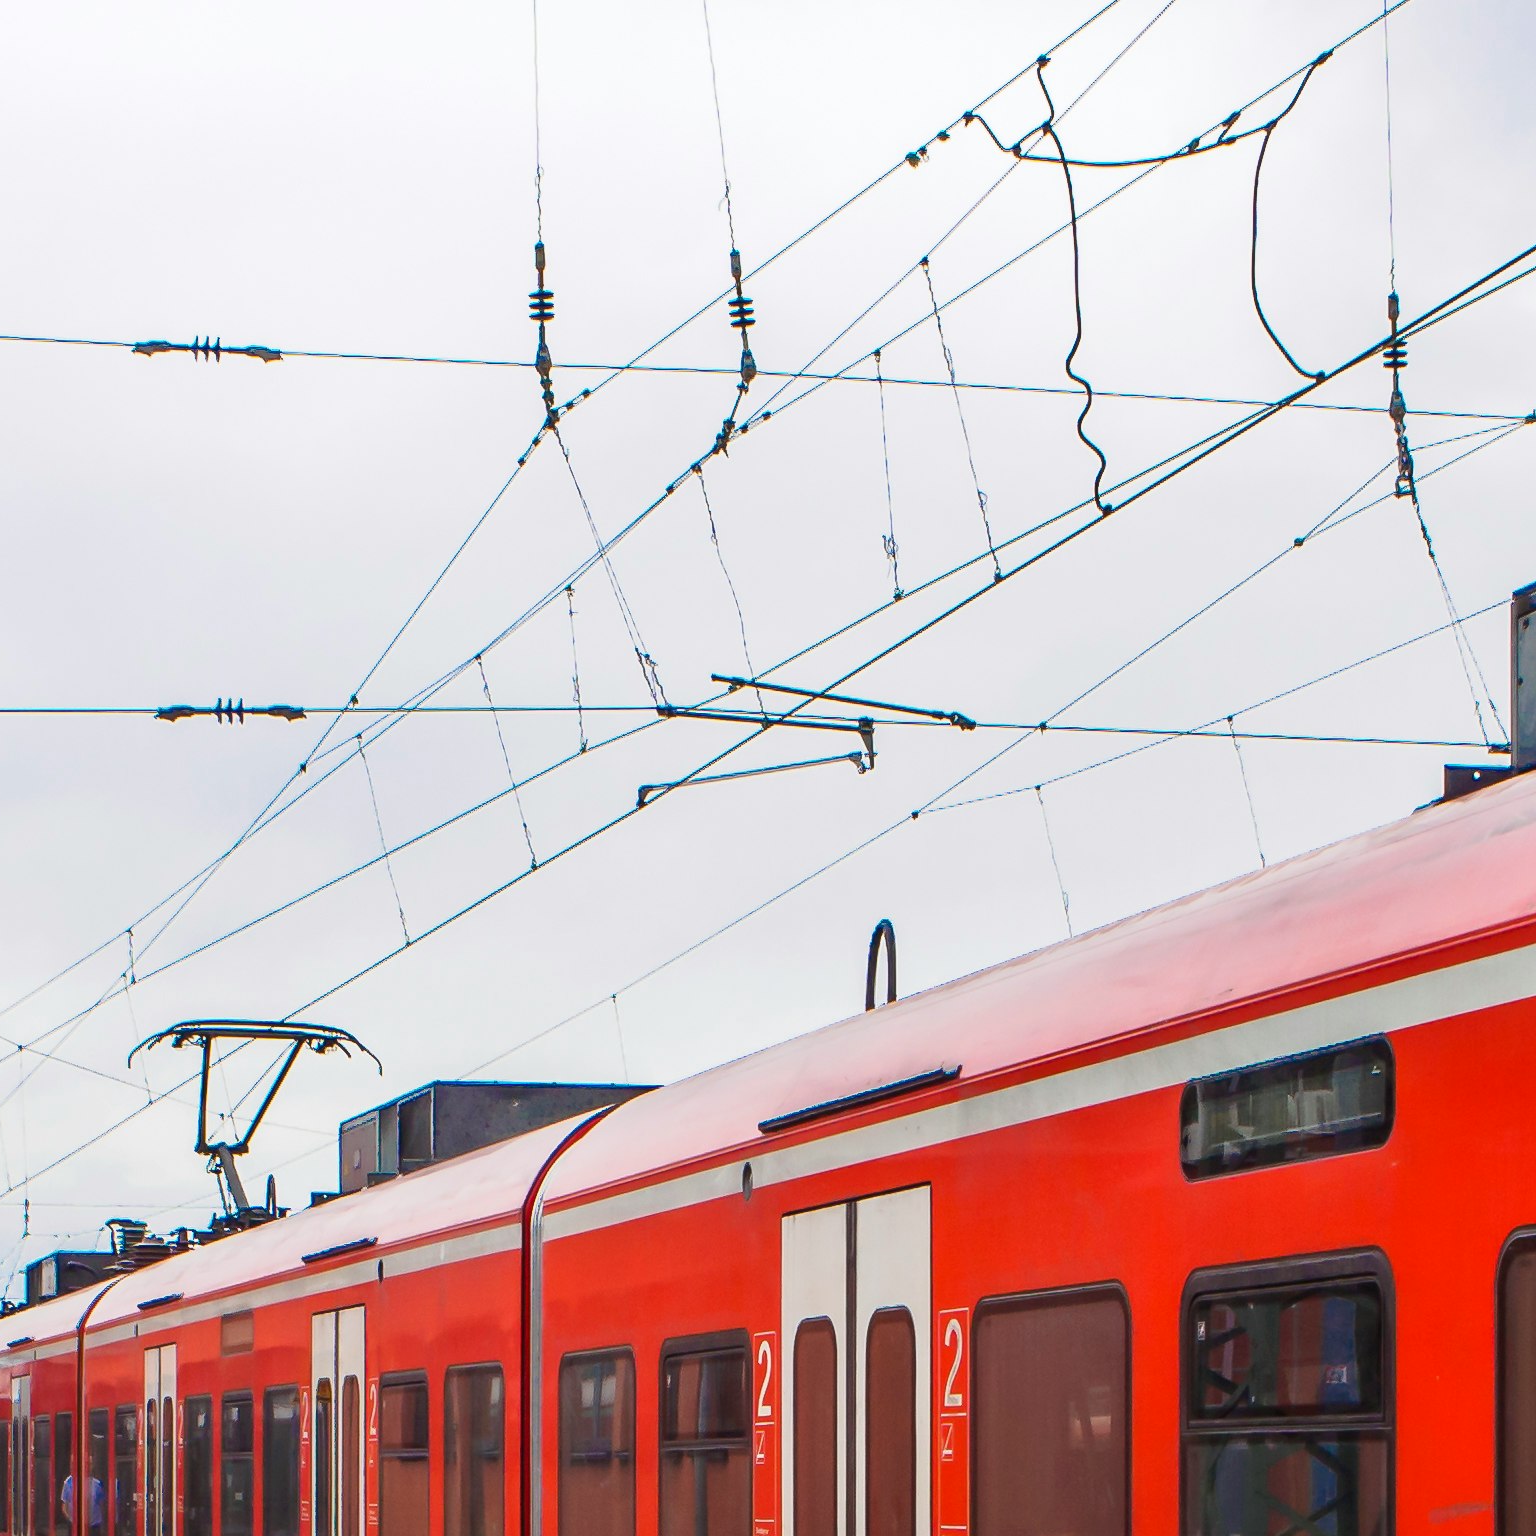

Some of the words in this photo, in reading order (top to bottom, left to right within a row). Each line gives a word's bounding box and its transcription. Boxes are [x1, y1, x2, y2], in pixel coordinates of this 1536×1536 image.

[757, 1340, 772, 1417] 2
[944, 1318, 963, 1407] 2
[369, 1383, 377, 1436] 2
